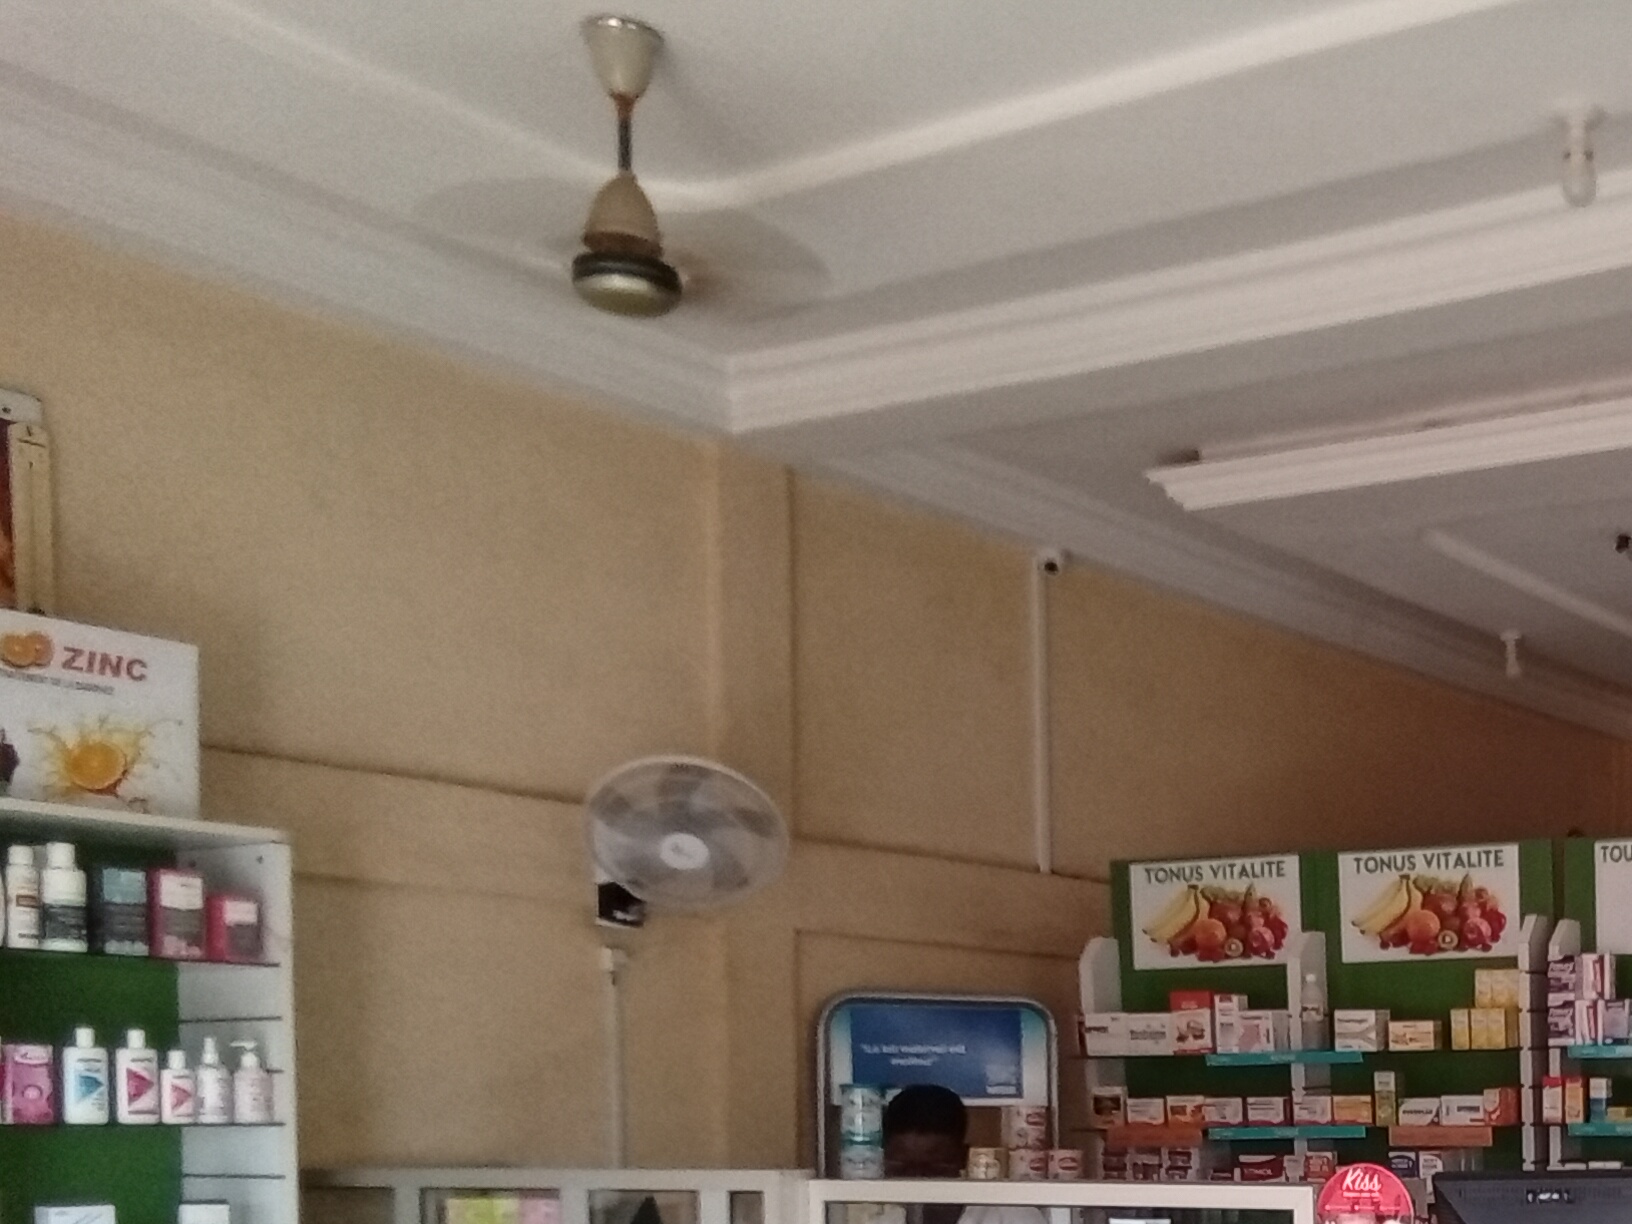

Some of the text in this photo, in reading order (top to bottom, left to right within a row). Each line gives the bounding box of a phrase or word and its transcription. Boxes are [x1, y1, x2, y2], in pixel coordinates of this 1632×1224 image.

[62, 646, 148, 682] ZINC
[1145, 860, 1286, 884] TONUS VITALITE
[1353, 850, 1505, 874] TONUS VITALITE
[1342, 1167, 1382, 1191] Kiss
